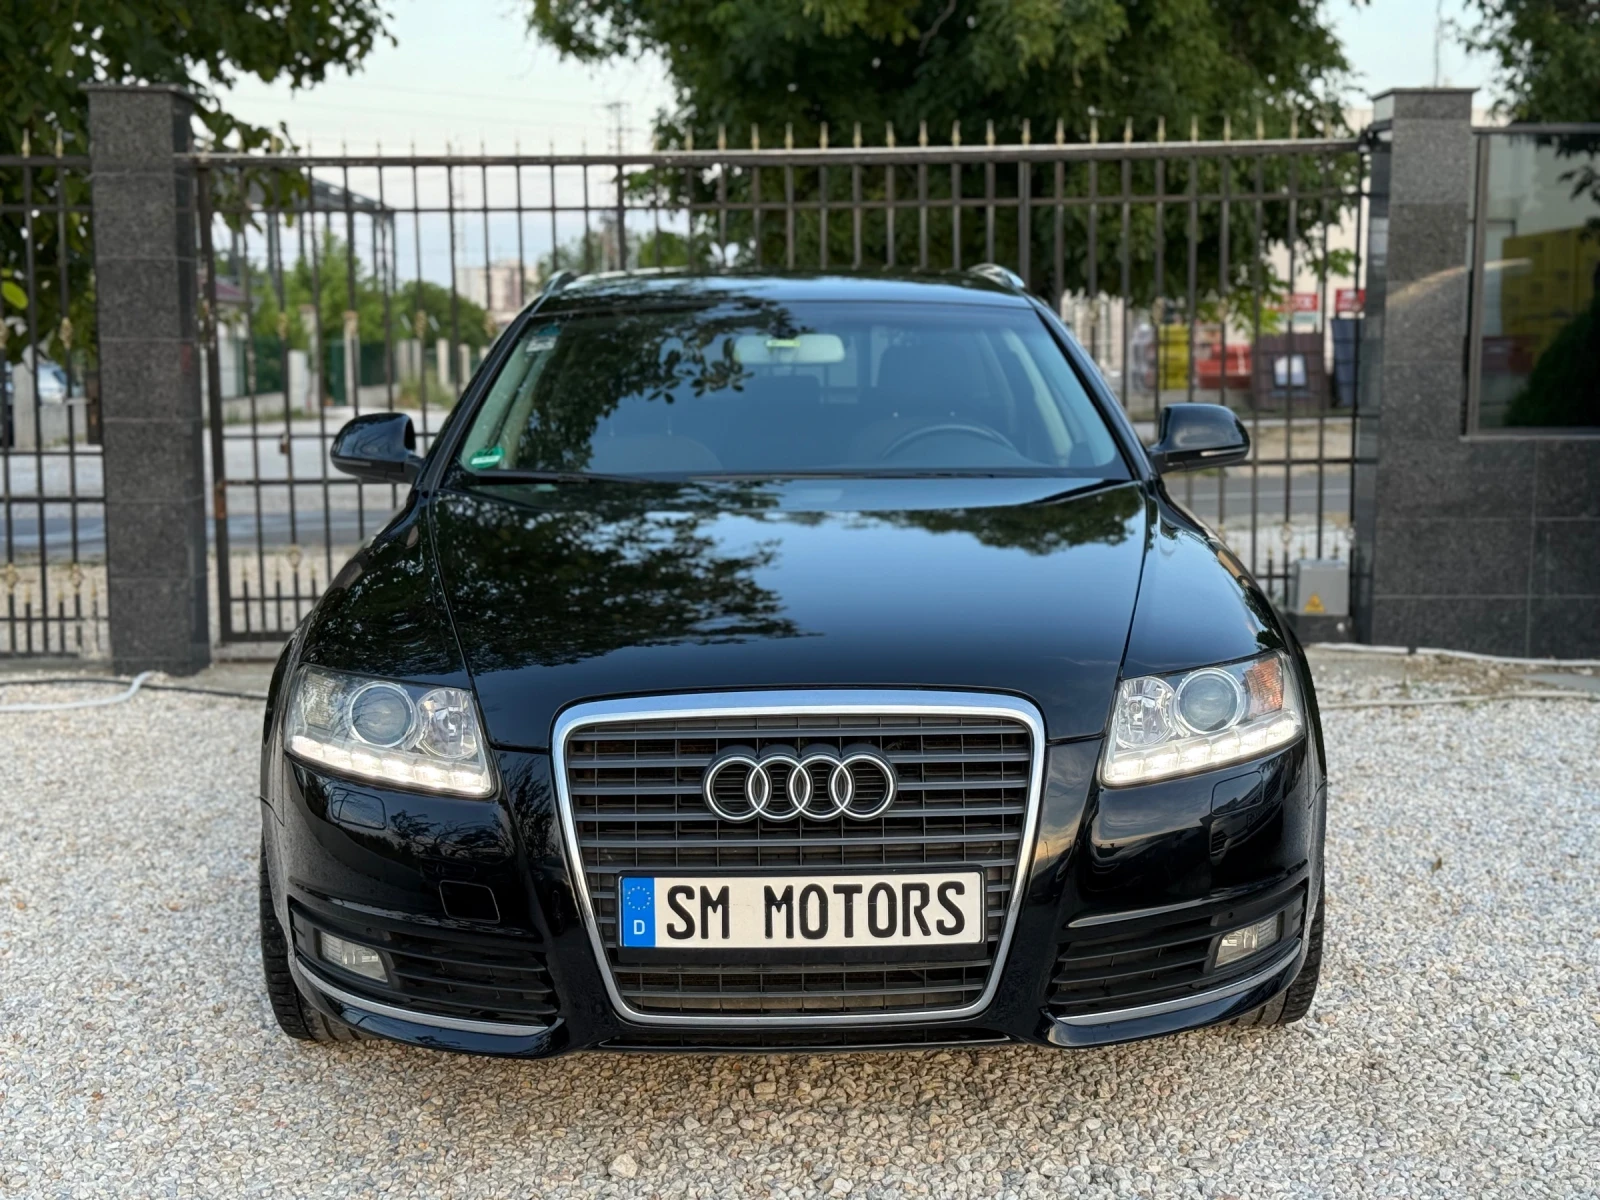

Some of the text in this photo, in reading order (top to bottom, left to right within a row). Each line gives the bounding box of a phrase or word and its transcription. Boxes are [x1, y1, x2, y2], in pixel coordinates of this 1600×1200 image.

[633, 919, 646, 935] D
[666, 880, 966, 940] SM MOTORS
